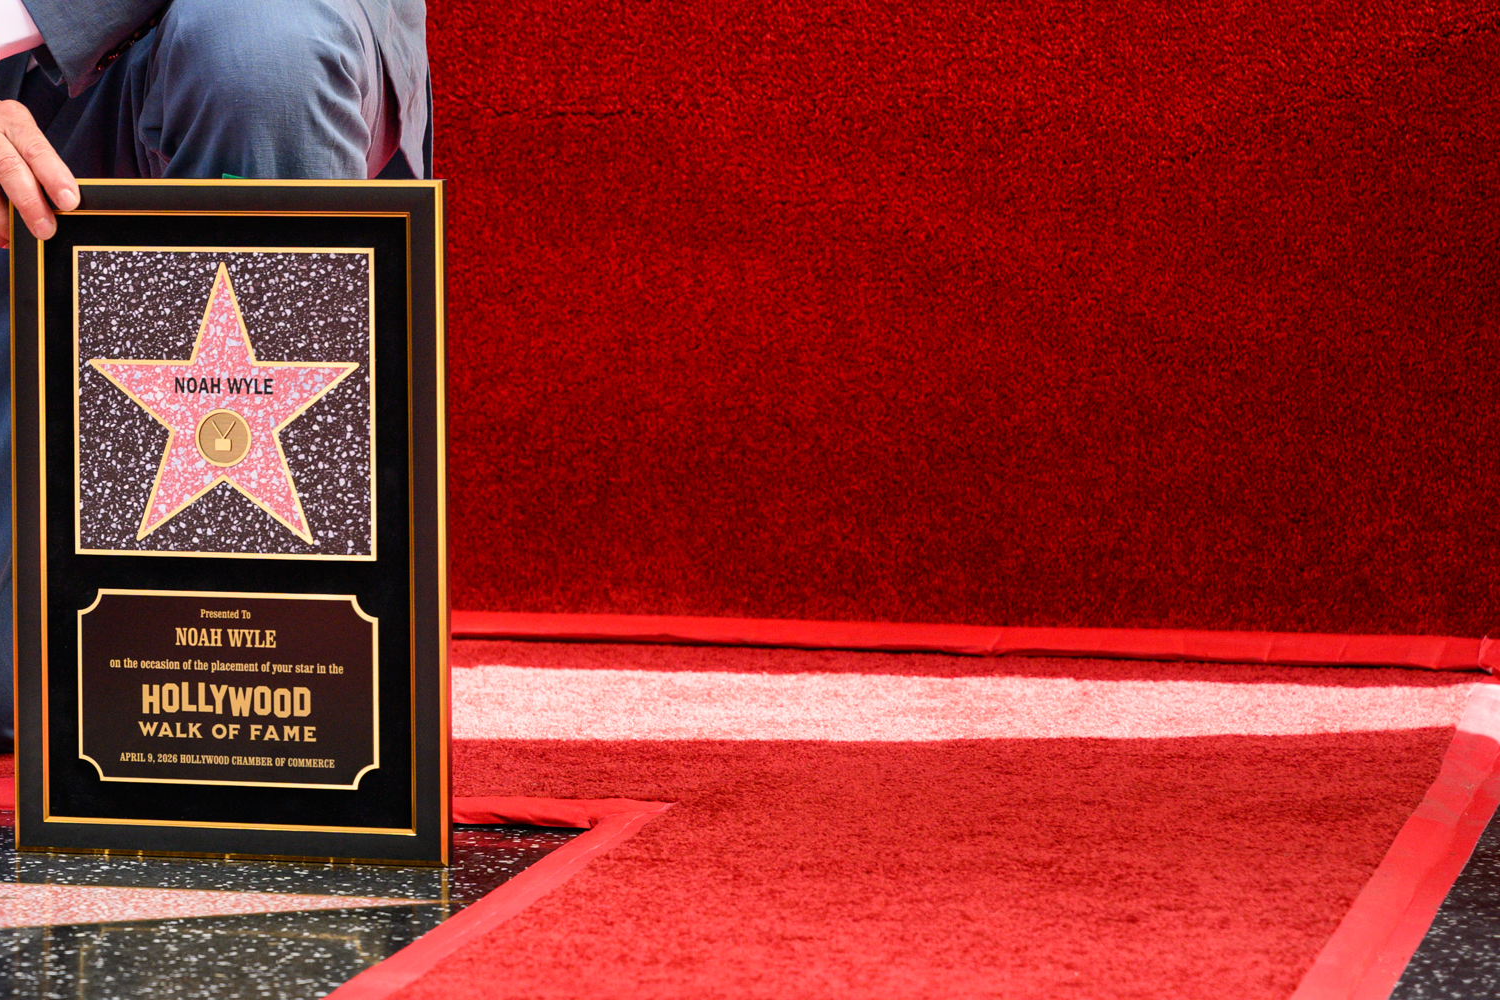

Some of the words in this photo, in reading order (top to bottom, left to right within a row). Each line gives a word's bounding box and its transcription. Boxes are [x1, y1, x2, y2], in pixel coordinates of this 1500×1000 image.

[174, 377, 220, 394] NOAH
[227, 377, 274, 395] WYLE
[200, 609, 239, 619] Presented
[241, 610, 251, 619] To
[175, 627, 222, 647] NOAH
[227, 629, 276, 648] WYLE
[110, 659, 121, 668] on
[124, 658, 138, 669] the
[140, 659, 180, 670] occasion
[182, 660, 192, 670] of
[194, 660, 208, 670] the
[211, 660, 258, 672] placement
[261, 662, 270, 672] of
[272, 663, 293, 675] your
[295, 663, 313, 674] star
[317, 663, 326, 674] in
[329, 664, 344, 674] the
[142, 682, 311, 718] HOLLYWOOD
[138, 721, 203, 738] WALK
[211, 724, 241, 739] OF
[250, 724, 317, 742] FAME
[120, 752, 145, 762] APRIL
[148, 753, 155, 763] 9,
[157, 754, 178, 763] 2026
[180, 754, 229, 765] HOLLYWOOD
[232, 756, 273, 766] CHAMBER
[275, 757, 286, 767] OF
[287, 758, 335, 769] COMMERCE
